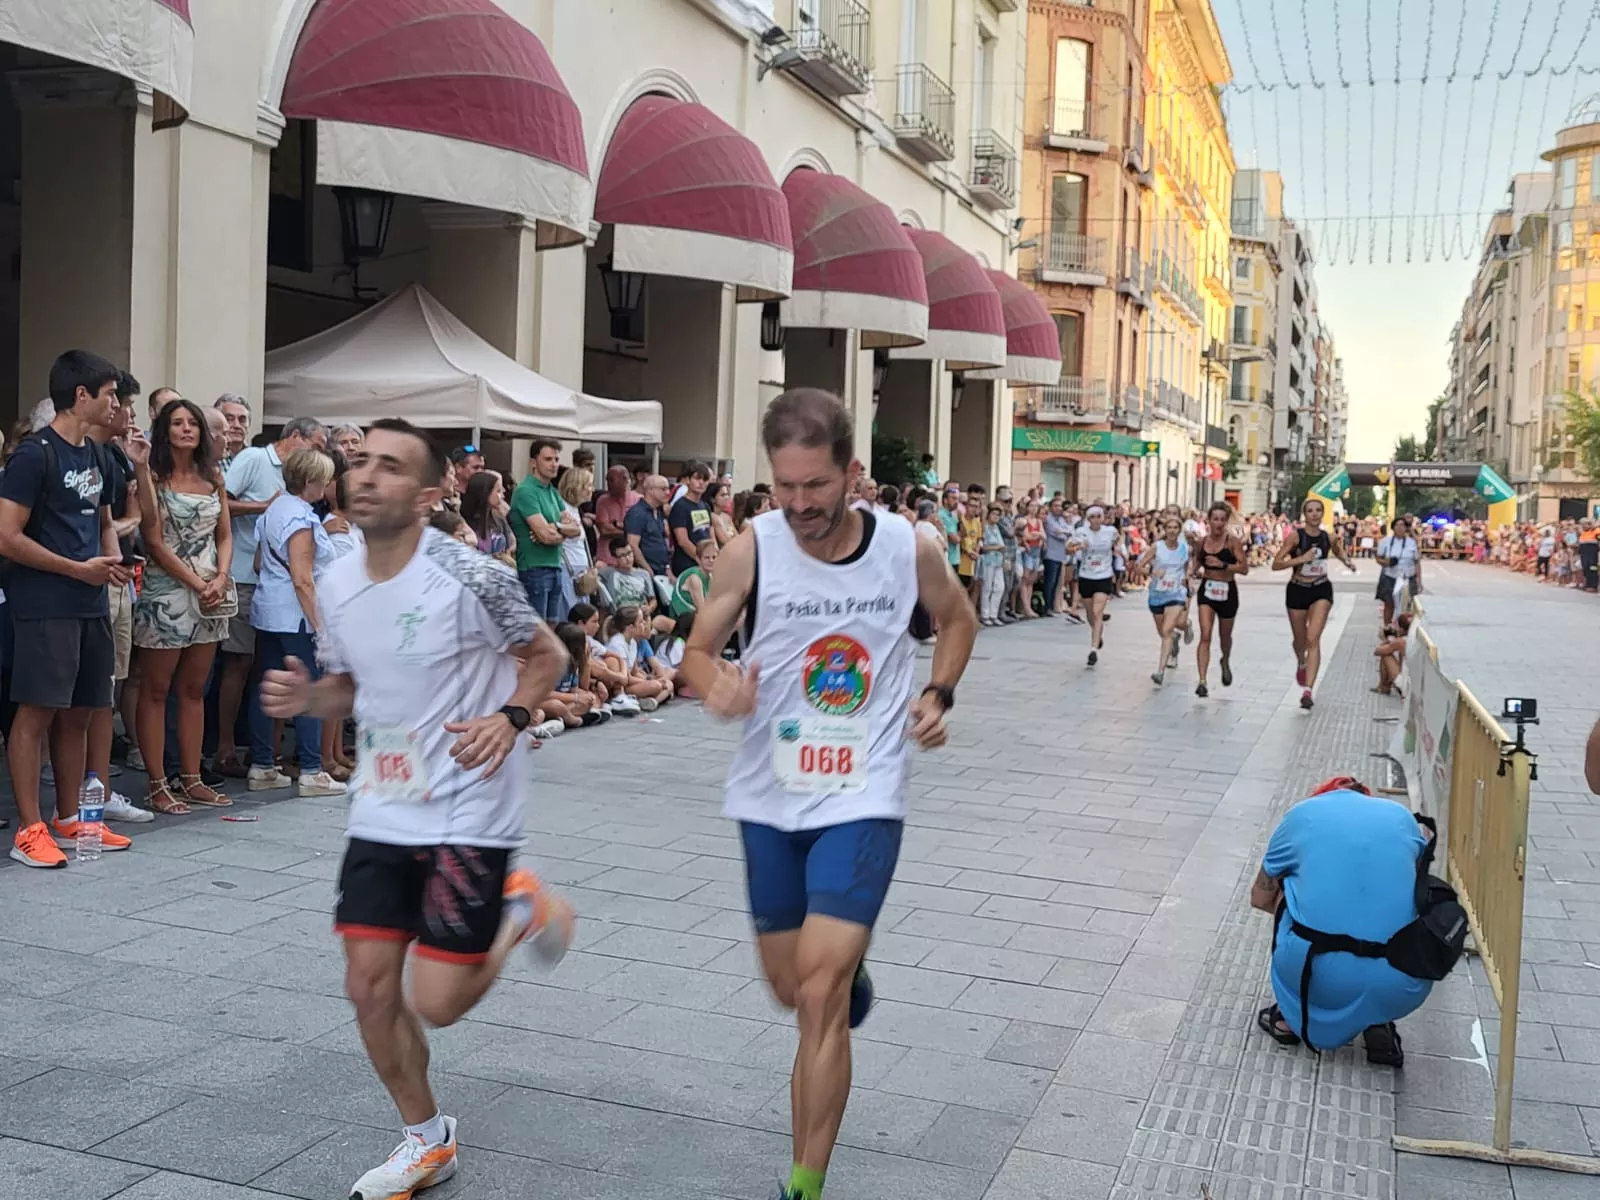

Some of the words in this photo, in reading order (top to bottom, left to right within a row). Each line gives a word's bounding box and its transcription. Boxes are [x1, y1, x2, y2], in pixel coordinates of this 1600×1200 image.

[1395, 468, 1419, 478] CAJA
[1420, 468, 1452, 478] RURAL
[800, 745, 852, 775] 068
